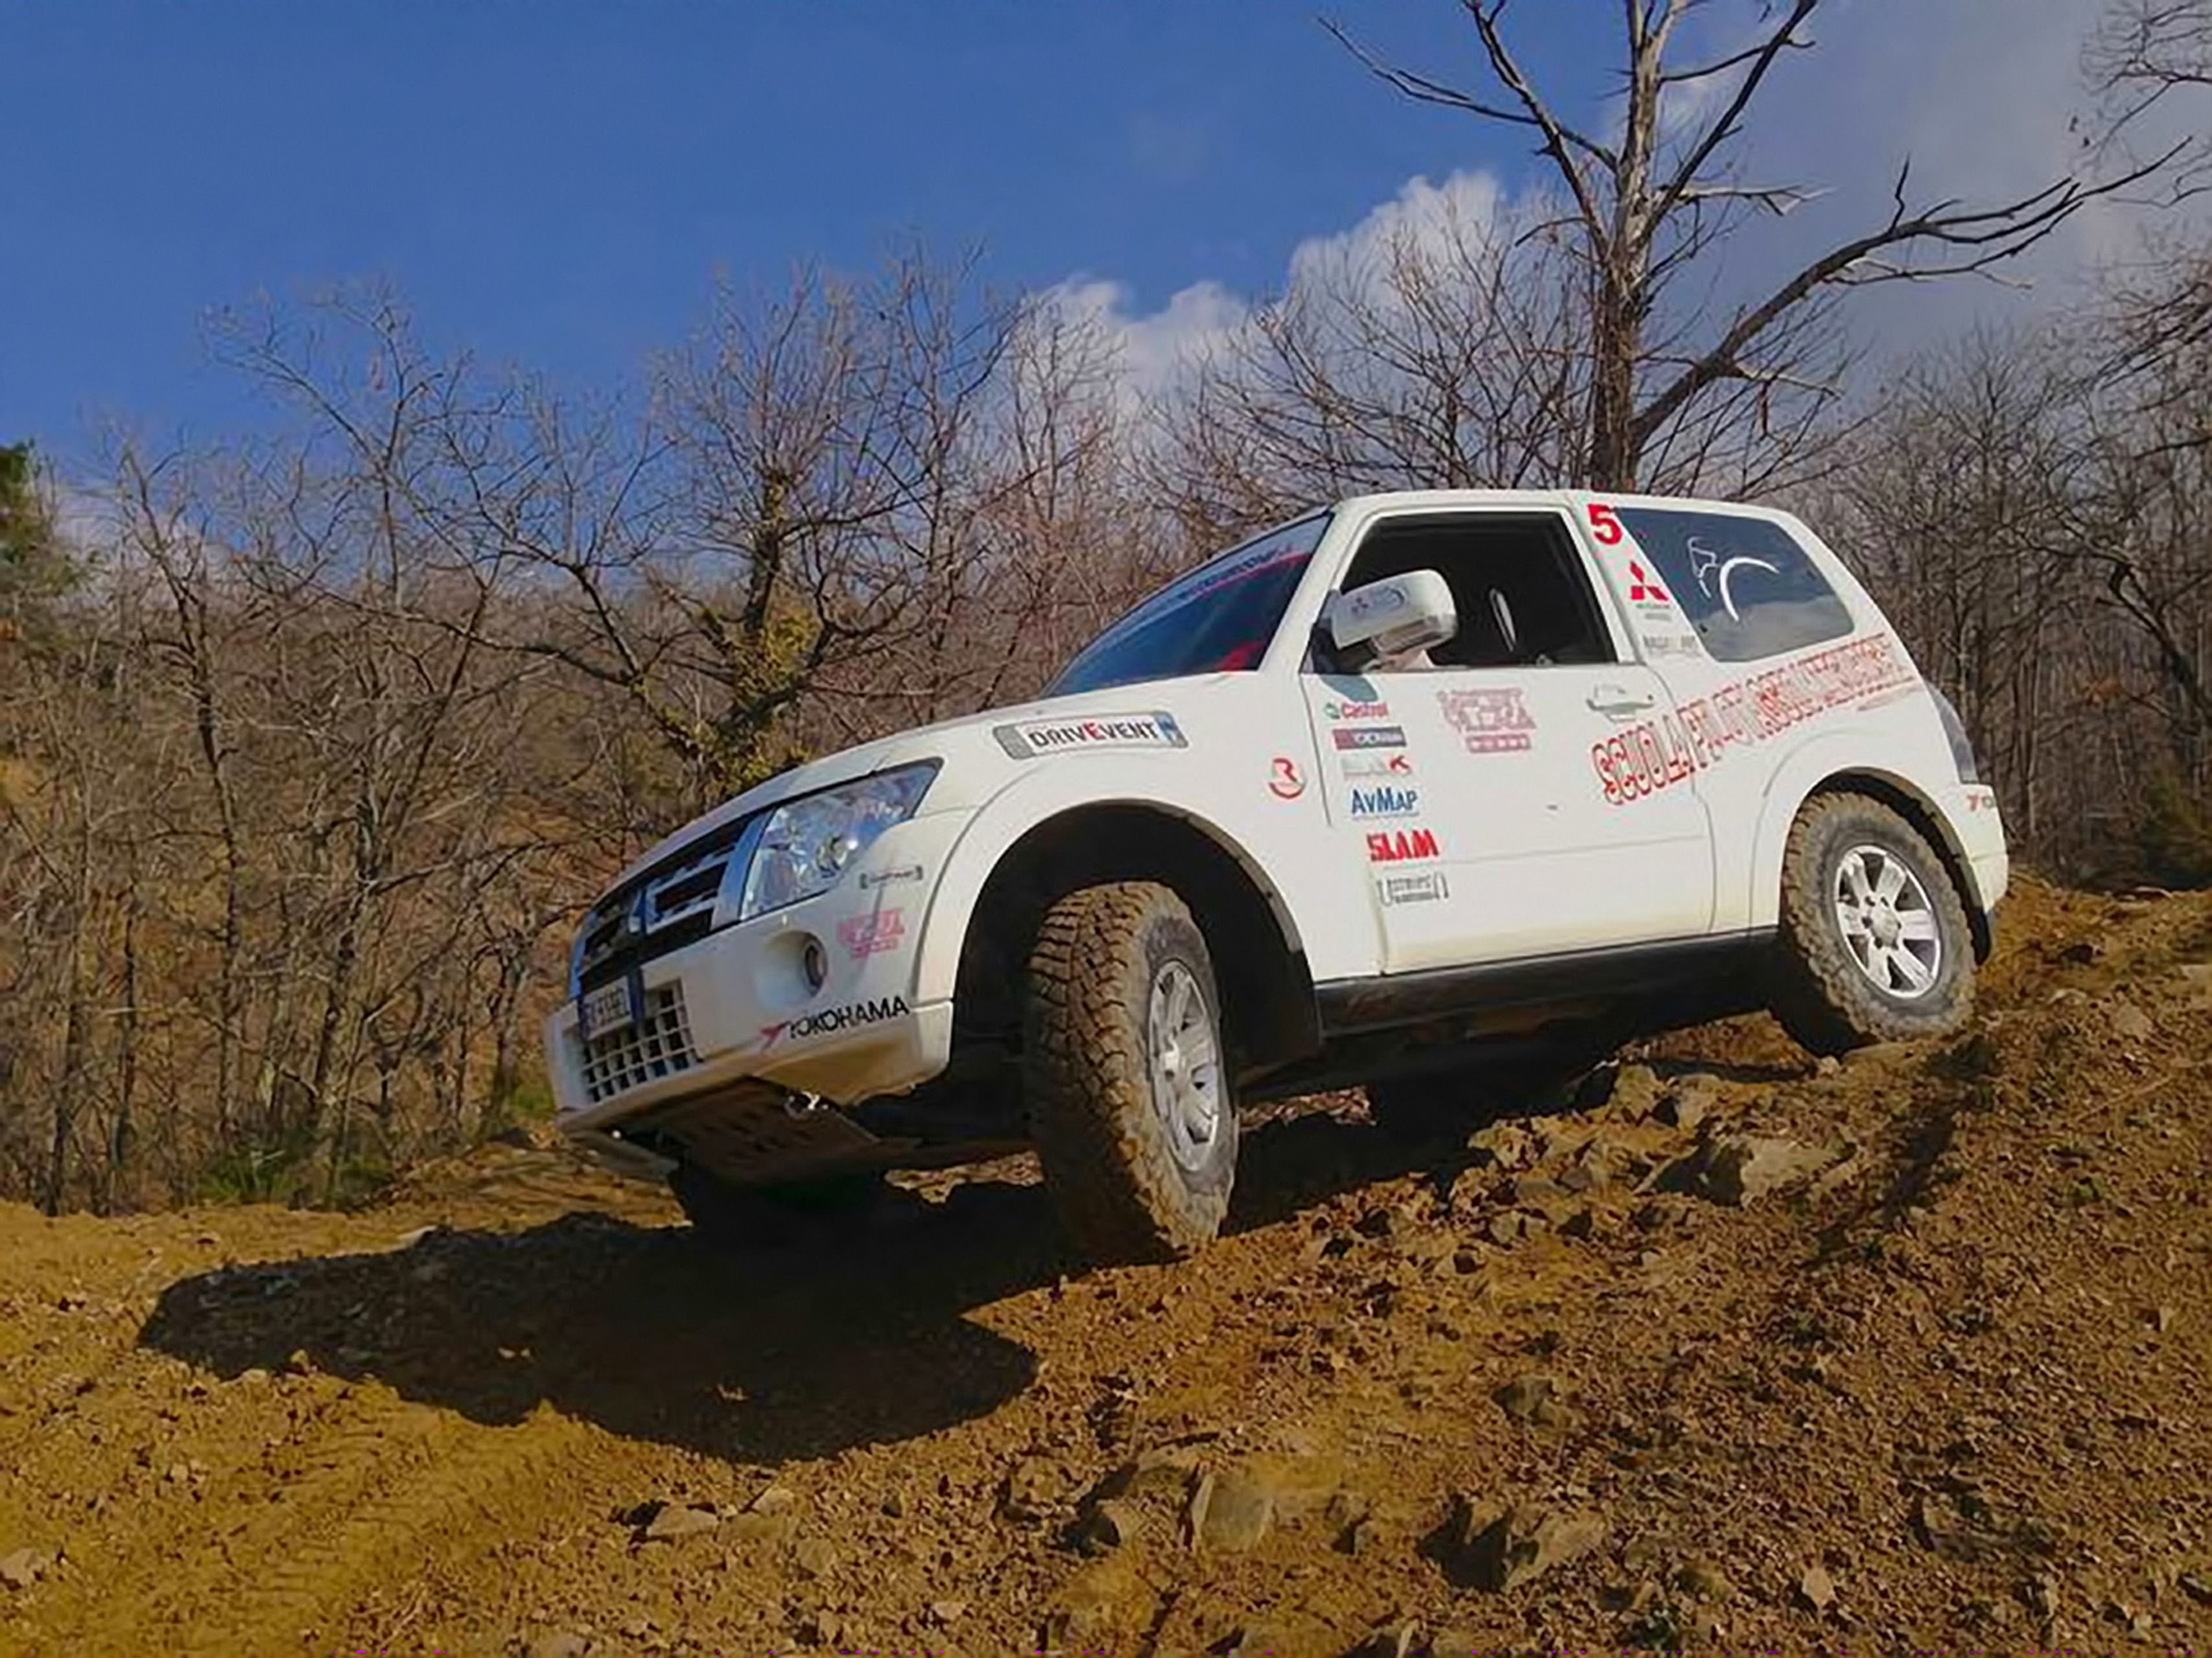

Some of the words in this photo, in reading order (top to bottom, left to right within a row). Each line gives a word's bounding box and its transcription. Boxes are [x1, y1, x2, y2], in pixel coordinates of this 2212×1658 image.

[1587, 504, 1623, 546] 5
[1028, 721, 1159, 748] DRIVEVENT
[1366, 828, 1440, 862] SLAM
[761, 994, 910, 1051] YOKOHAMA
